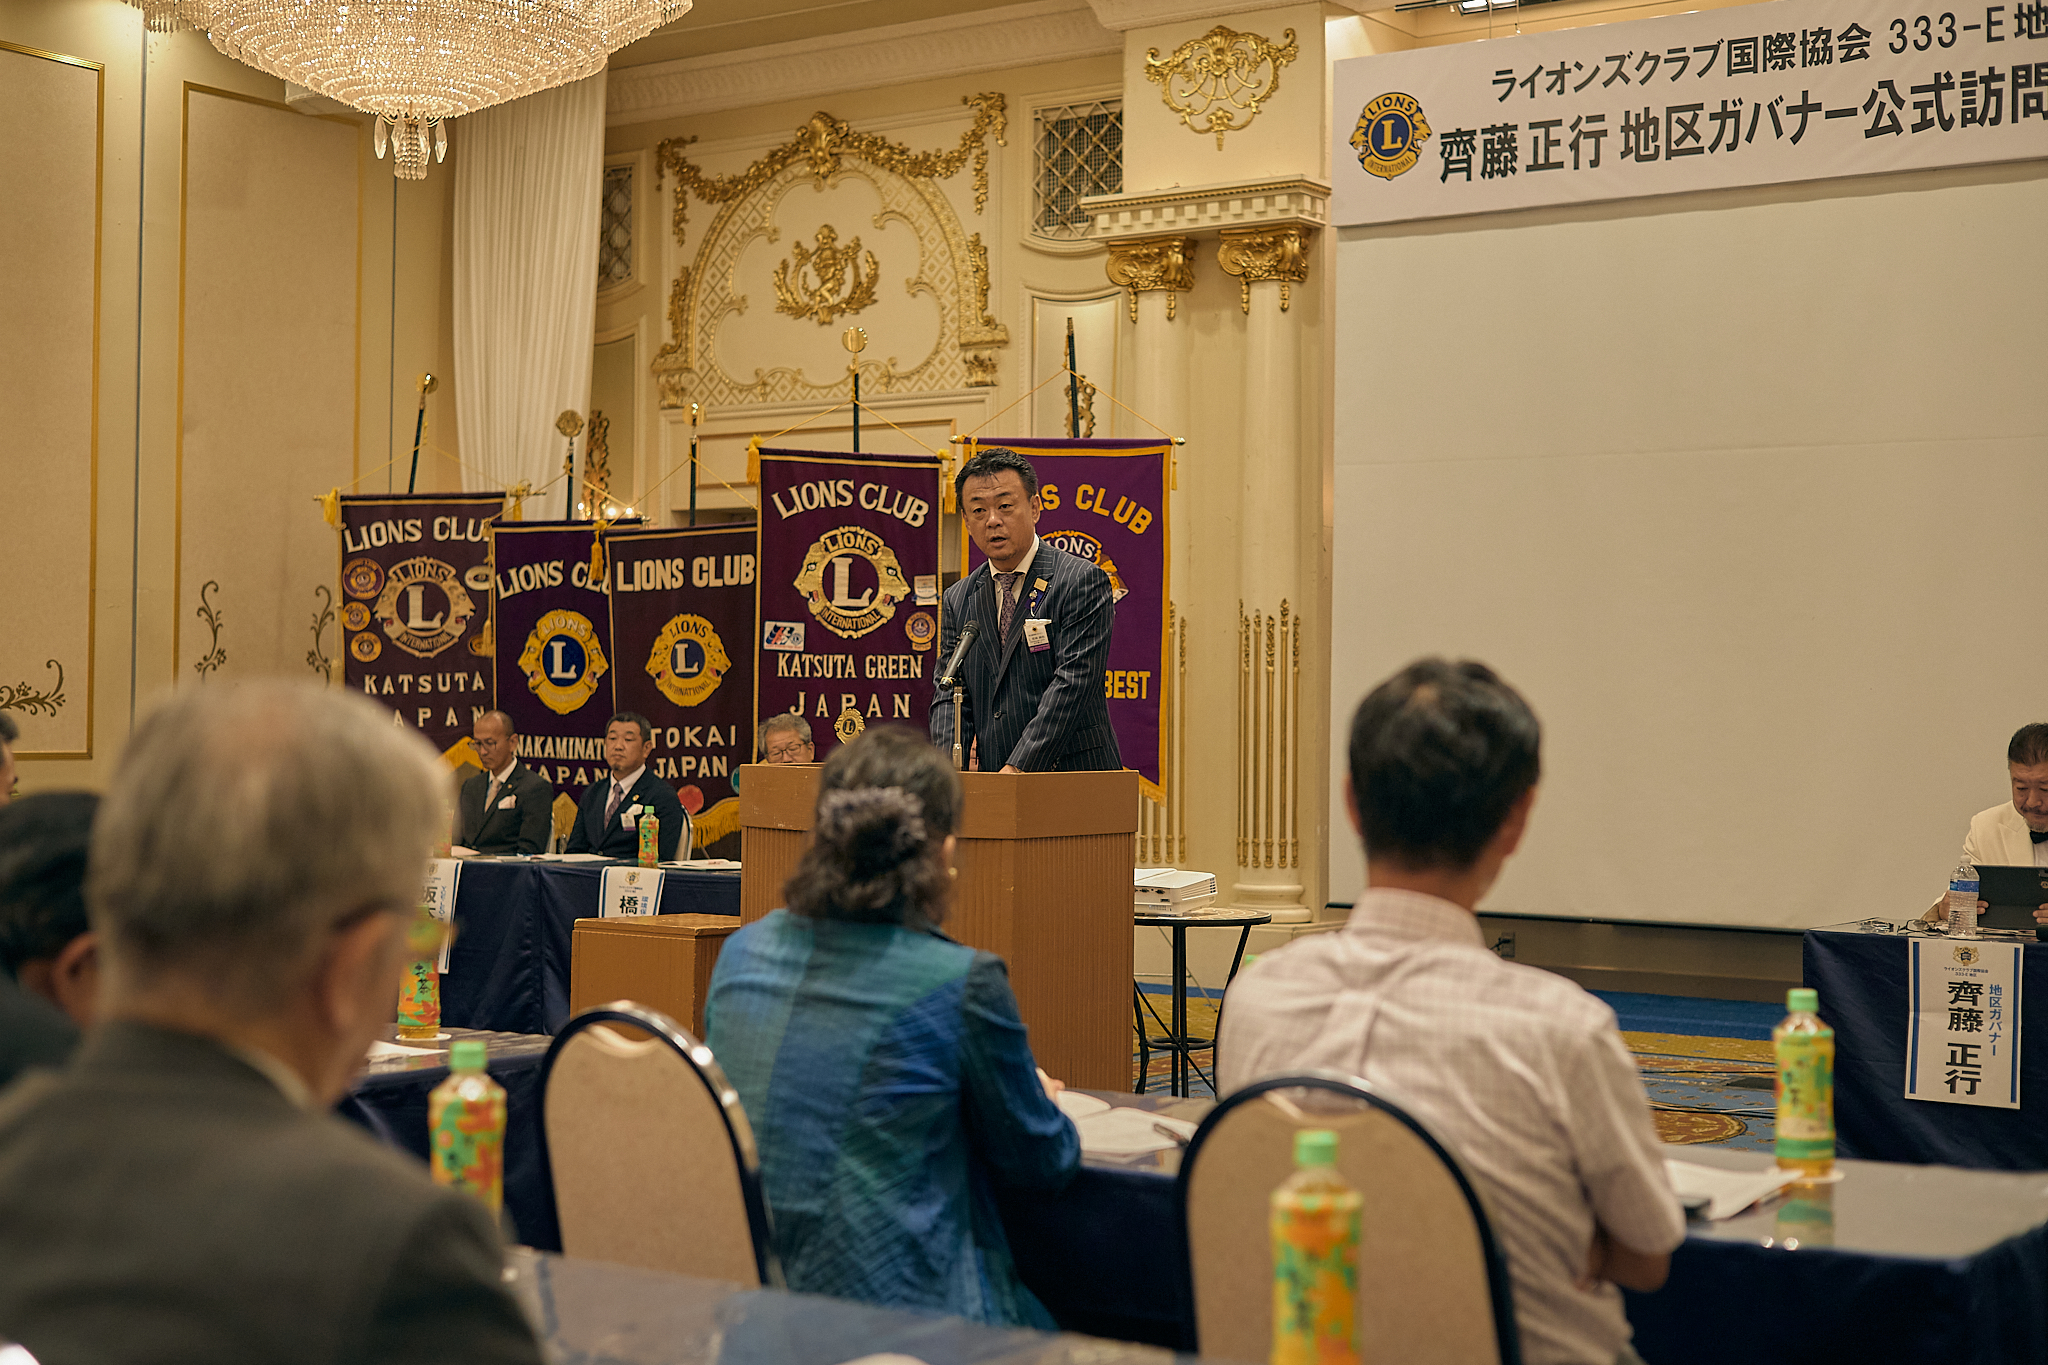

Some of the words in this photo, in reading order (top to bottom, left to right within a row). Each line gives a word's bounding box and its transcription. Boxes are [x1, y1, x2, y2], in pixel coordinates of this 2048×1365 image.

[1492, 22, 1872, 103] ライオンズクラブ国際協会
[1367, 96, 1415, 117] LIONS
[1381, 119, 1403, 150] L
[1367, 155, 1414, 173] INTERNATIONAL
[771, 478, 855, 521] LIONS
[858, 482, 930, 528] CLUB
[1075, 483, 1153, 535] CLUB
[344, 518, 423, 554] LIONS
[432, 515, 491, 543] CLU
[825, 531, 879, 555] LIONS
[392, 561, 453, 585] LIONS
[496, 558, 565, 600] LIONS
[617, 557, 685, 592] LIONS
[692, 553, 756, 587] CLUB
[831, 556, 874, 608] L
[406, 584, 444, 630] L
[820, 606, 881, 631] INTERNATIONAL
[541, 615, 588, 638] LIONS
[669, 620, 709, 639] LIONS
[400, 629, 453, 652] INTERNATIONAL
[550, 641, 577, 679] L
[674, 643, 699, 674] L
[777, 652, 858, 679] KATSUTA
[865, 654, 923, 679] GREEN
[364, 670, 486, 695] KATSUTA
[666, 679, 712, 698] INTERNATIONAL
[393, 705, 485, 728] APAN
[789, 691, 912, 719] JAPAN
[513, 734, 606, 762] NAKAMINAT
[650, 724, 737, 750] TOKAI
[524, 762, 610, 787] APAN
[654, 755, 728, 780] JAPAN
[1988, 983, 2003, 1056] 地区ガバナー
